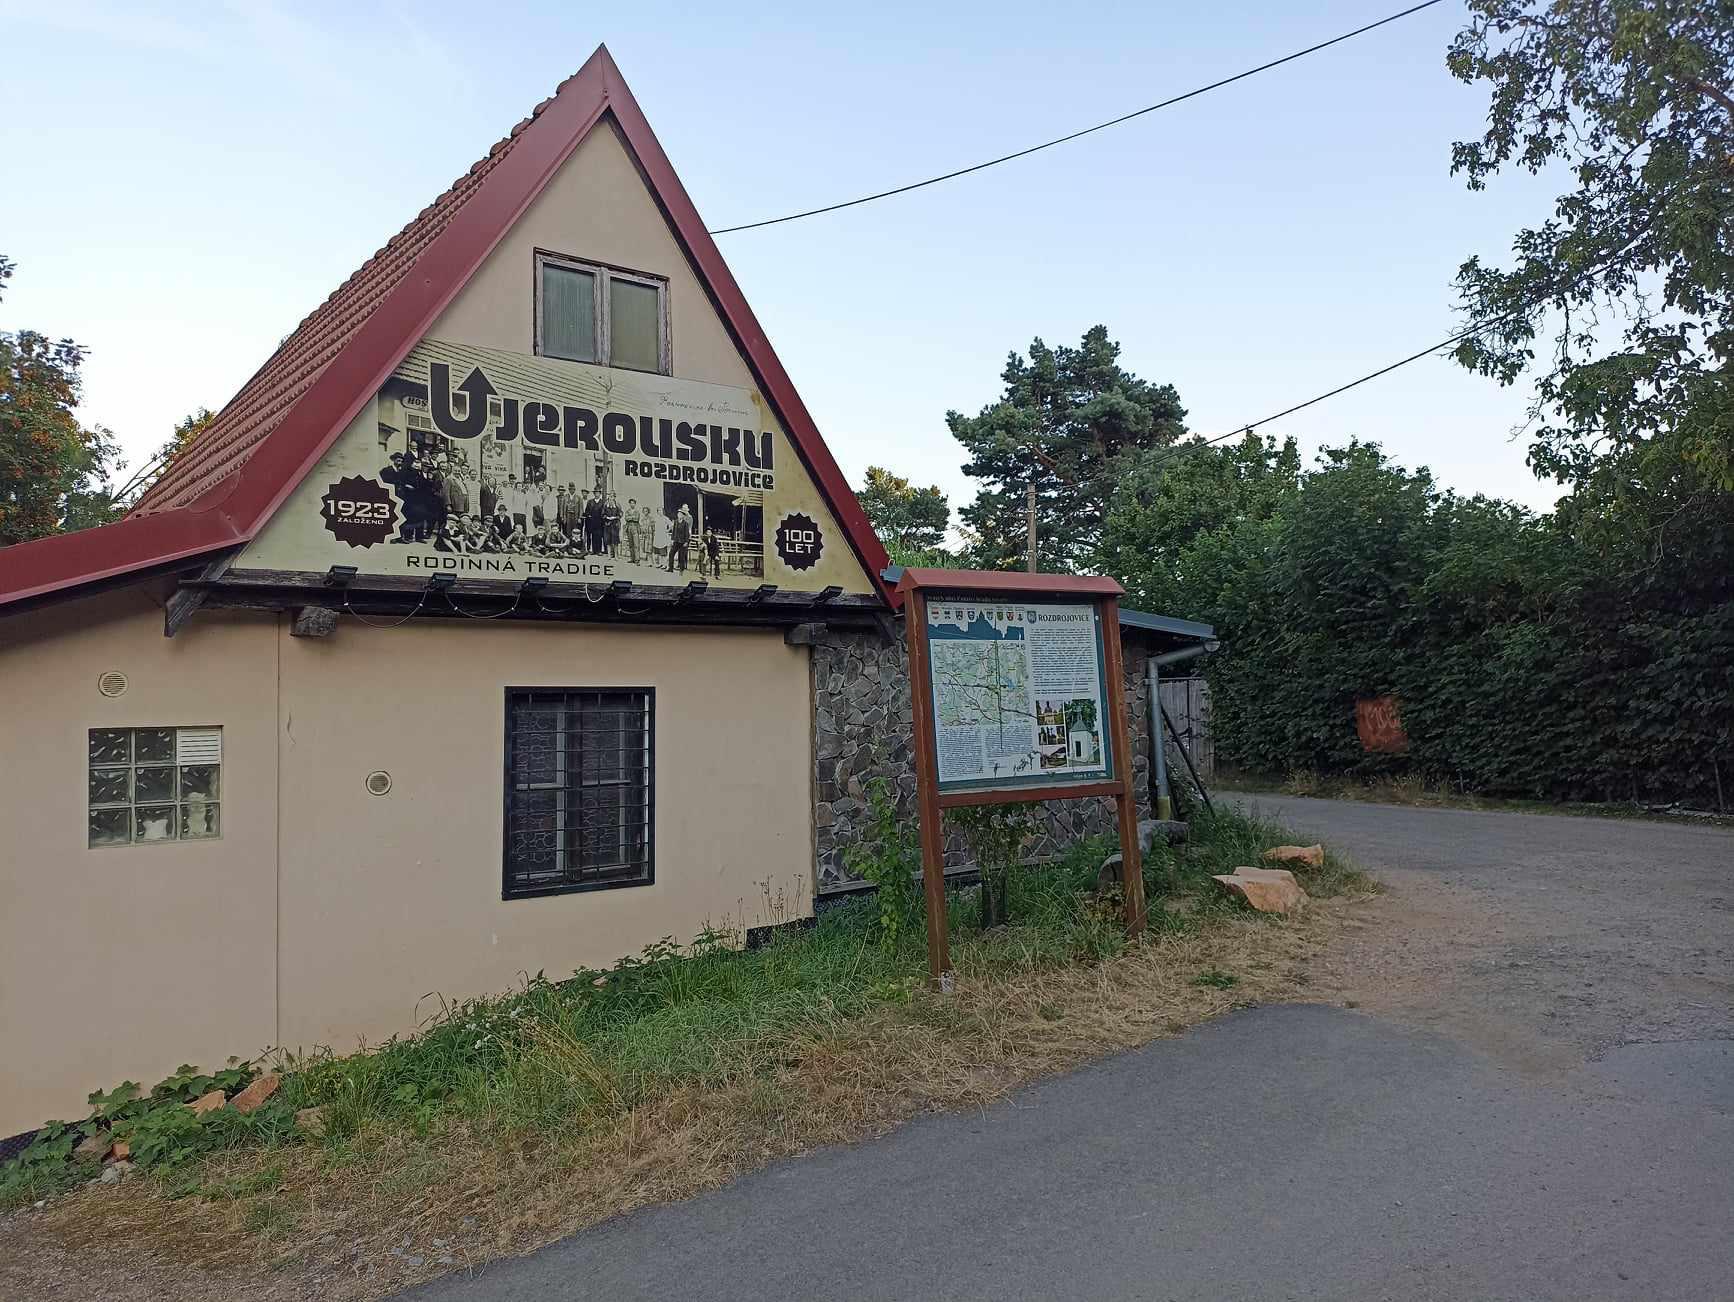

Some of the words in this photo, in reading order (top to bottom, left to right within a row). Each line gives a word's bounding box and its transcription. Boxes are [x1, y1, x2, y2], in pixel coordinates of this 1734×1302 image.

[327, 499, 390, 519] 1923
[783, 529, 814, 543] 100
[785, 542, 815, 554] LET
[406, 555, 516, 573] RODINNÁ
[524, 560, 615, 577] TRADICE
[1037, 613, 1089, 622] ROZDROJOVICE
